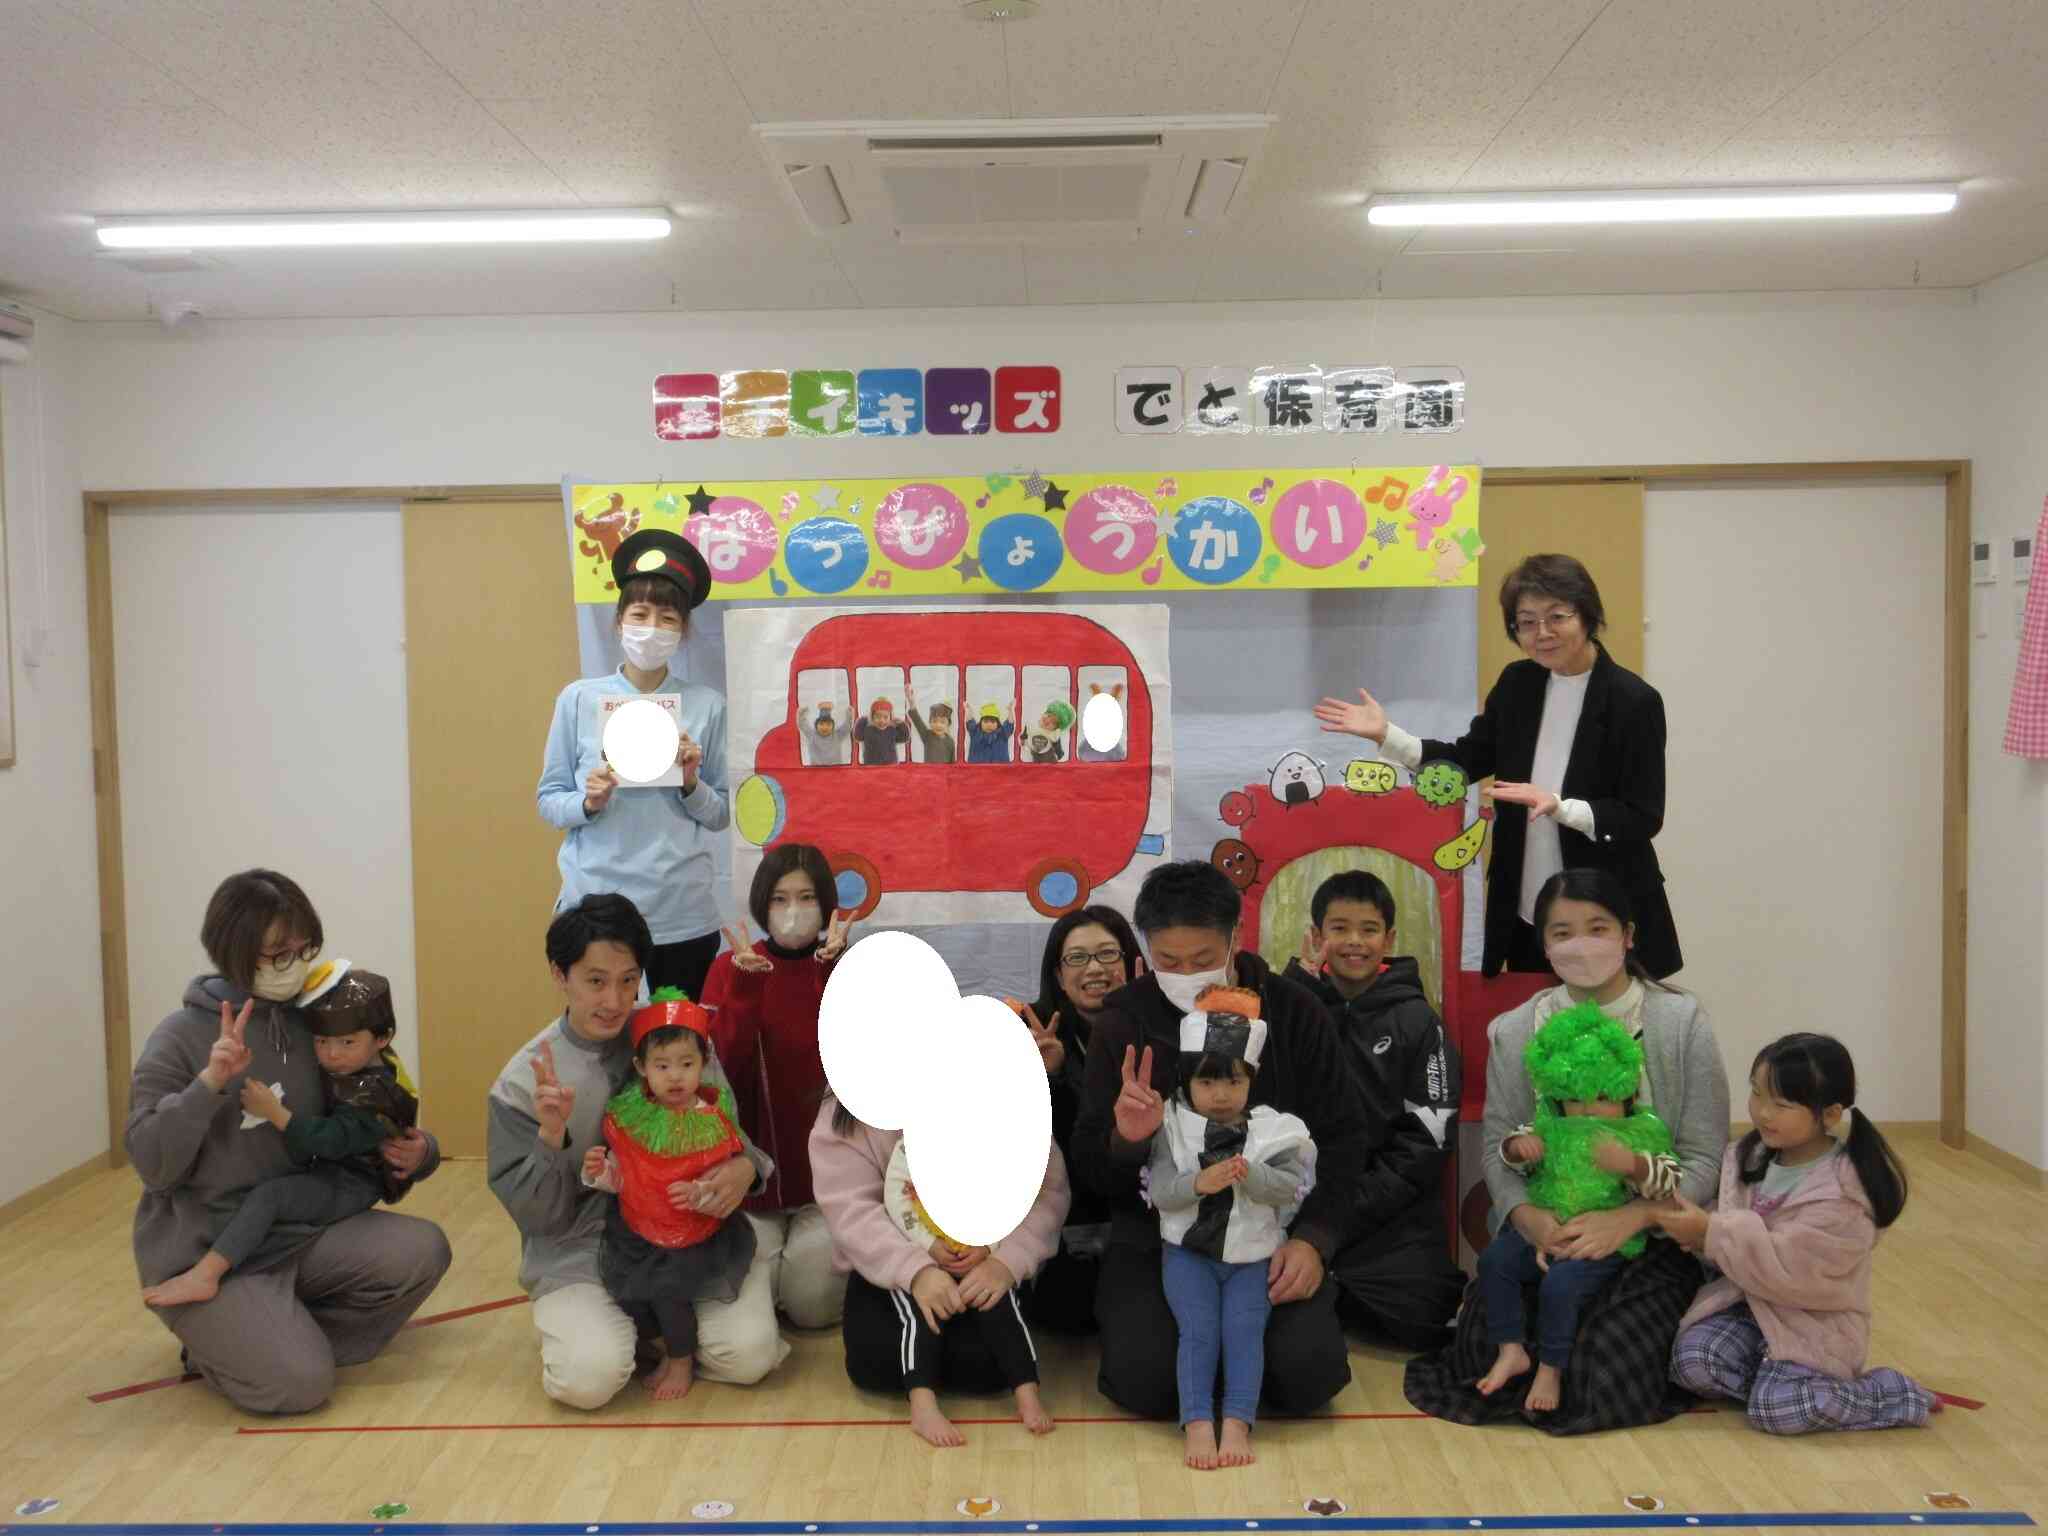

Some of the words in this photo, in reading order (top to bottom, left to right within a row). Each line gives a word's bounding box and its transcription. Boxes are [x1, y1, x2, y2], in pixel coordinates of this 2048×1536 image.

[1127, 379, 1454, 430] でと保育園
[699, 504, 1344, 572] はっぴょうかい
